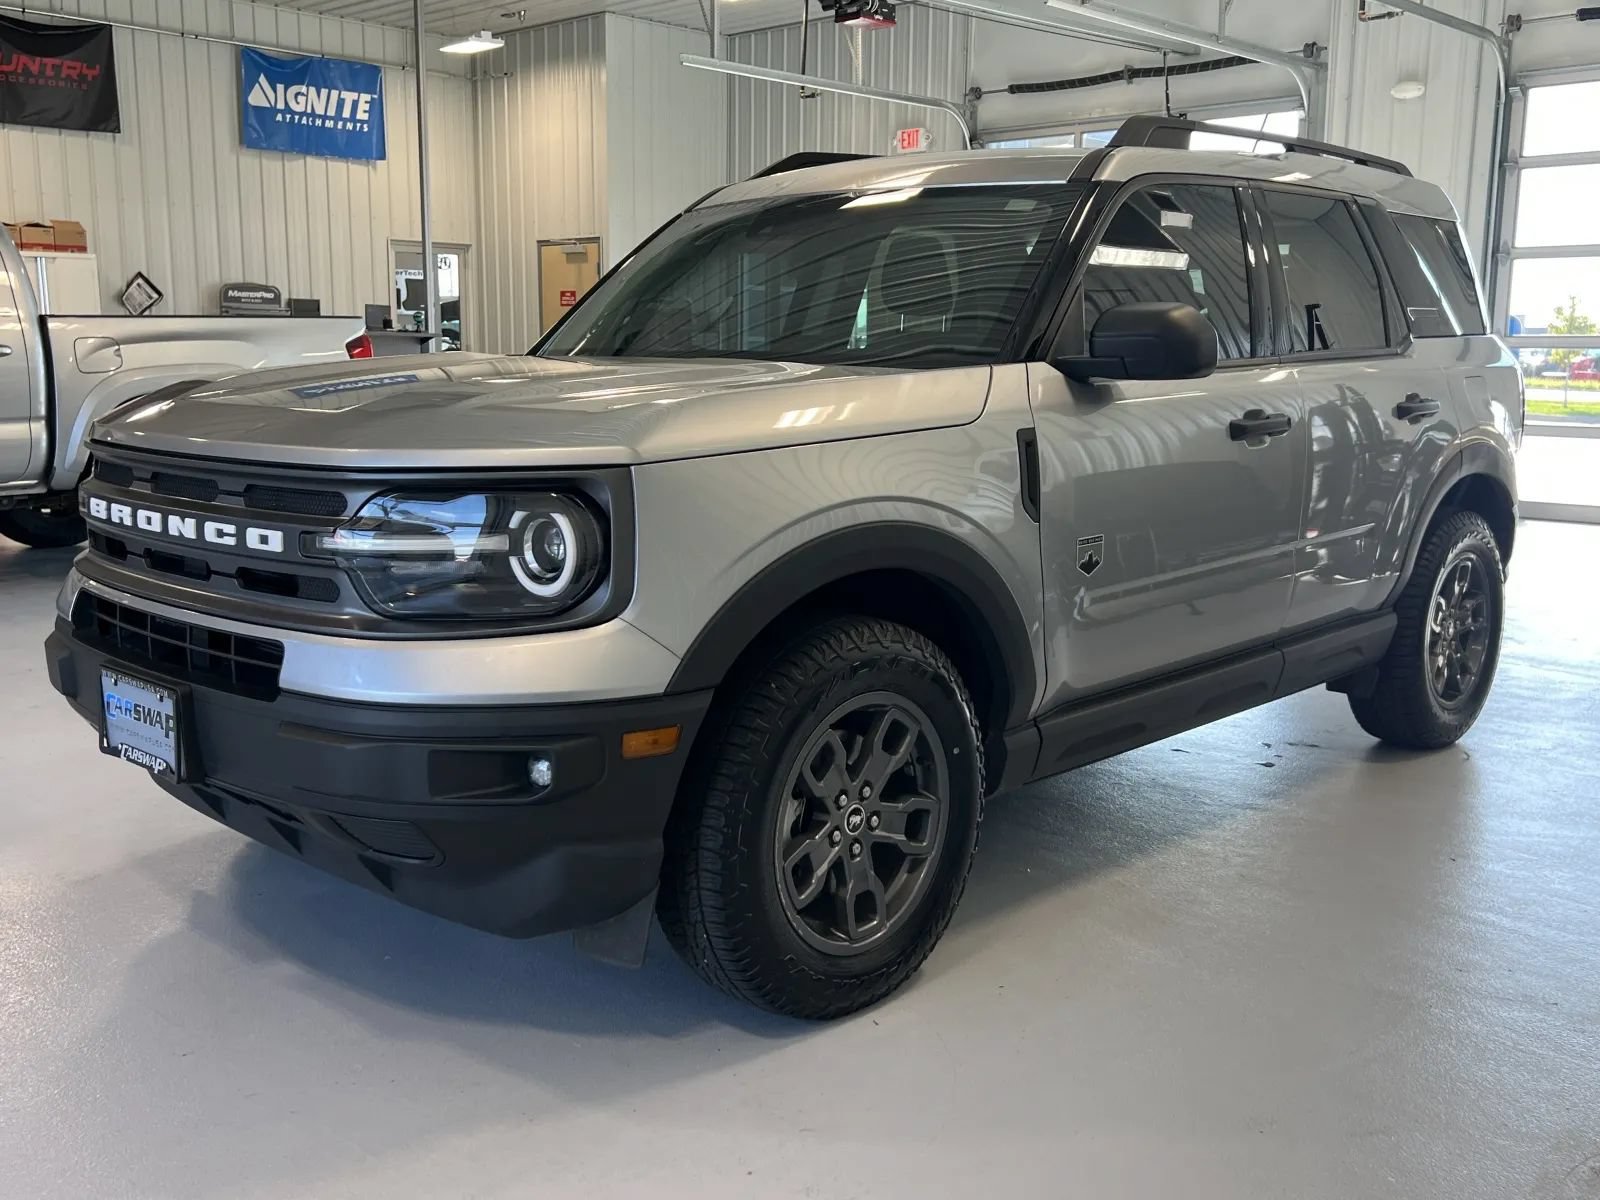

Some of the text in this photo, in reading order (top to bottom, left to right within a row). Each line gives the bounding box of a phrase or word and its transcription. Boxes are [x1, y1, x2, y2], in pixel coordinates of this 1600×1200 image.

[275, 84, 371, 120] IGNITE
[275, 113, 369, 132] ATTACHMENTS
[901, 129, 920, 149] EXIT
[89, 497, 284, 552] BRONCO
[106, 692, 176, 739] CARSWAP
[120, 743, 165, 774] CARSWAP
